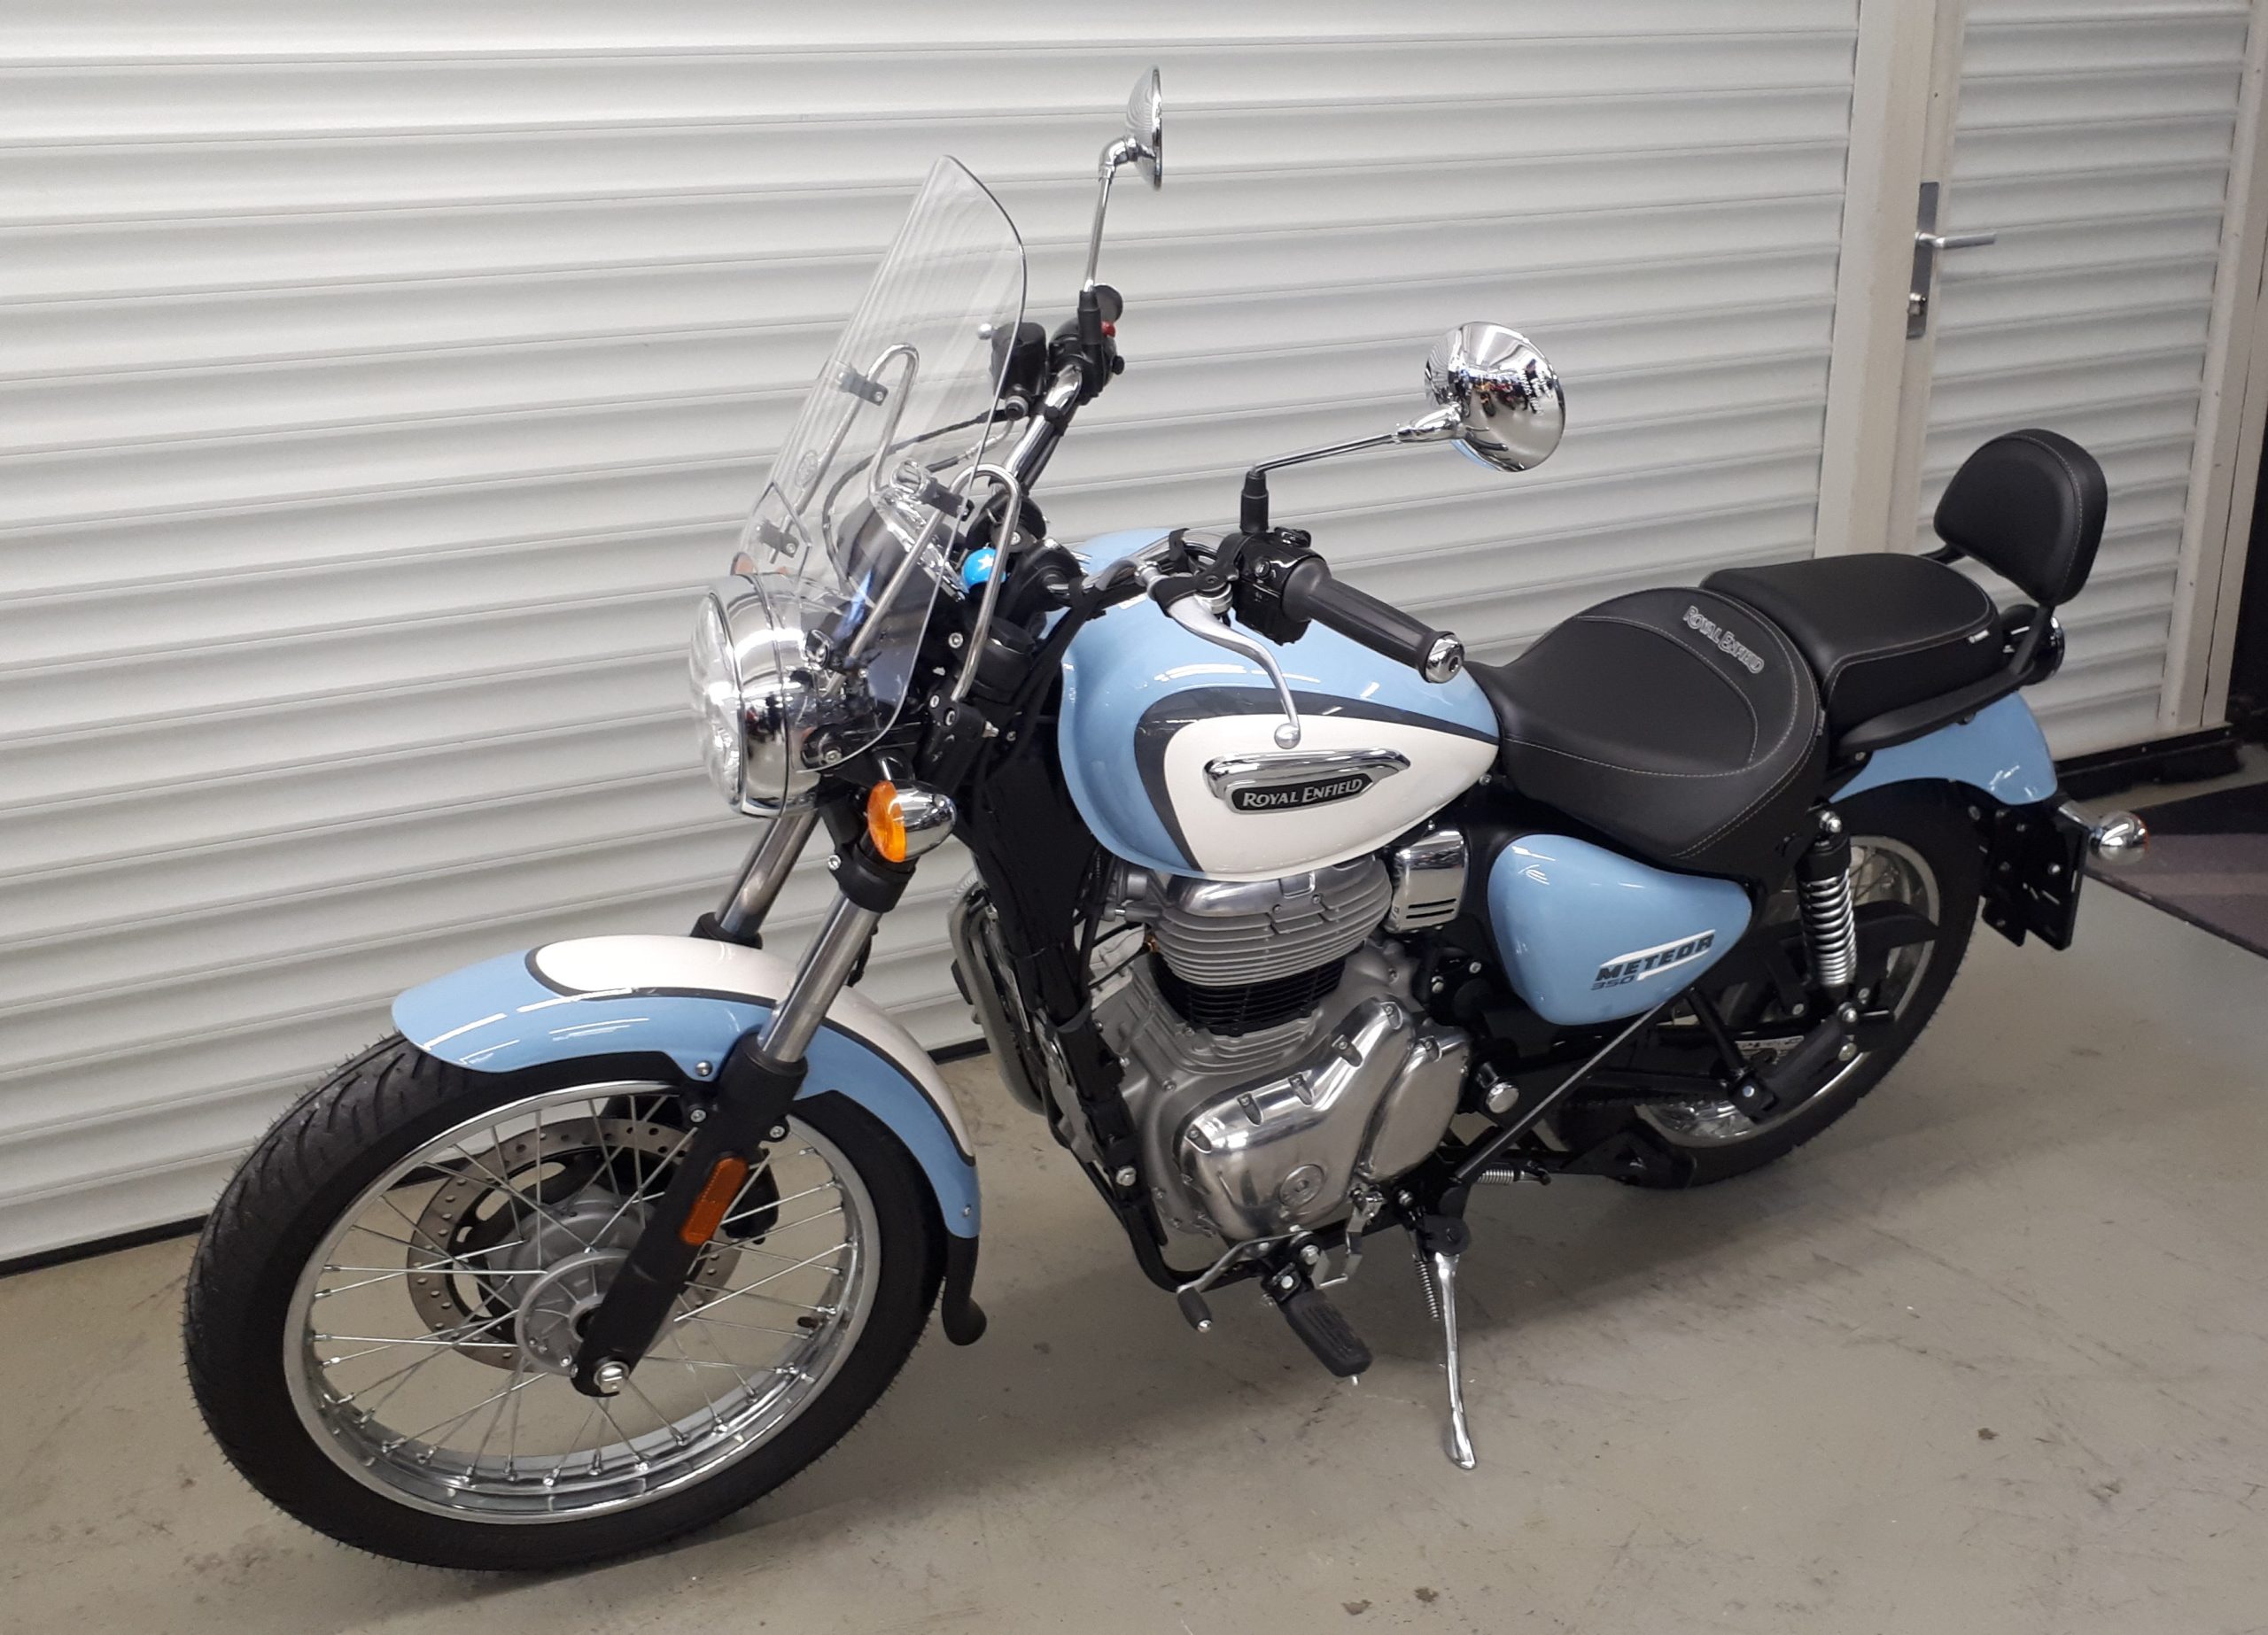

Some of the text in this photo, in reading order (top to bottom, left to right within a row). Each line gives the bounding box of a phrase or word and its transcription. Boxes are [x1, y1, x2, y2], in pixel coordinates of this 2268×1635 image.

[1242, 778, 1363, 808] ROYAL ENFIELD
[1595, 934, 1714, 982] METEOR
[1590, 975, 1635, 991] 350
